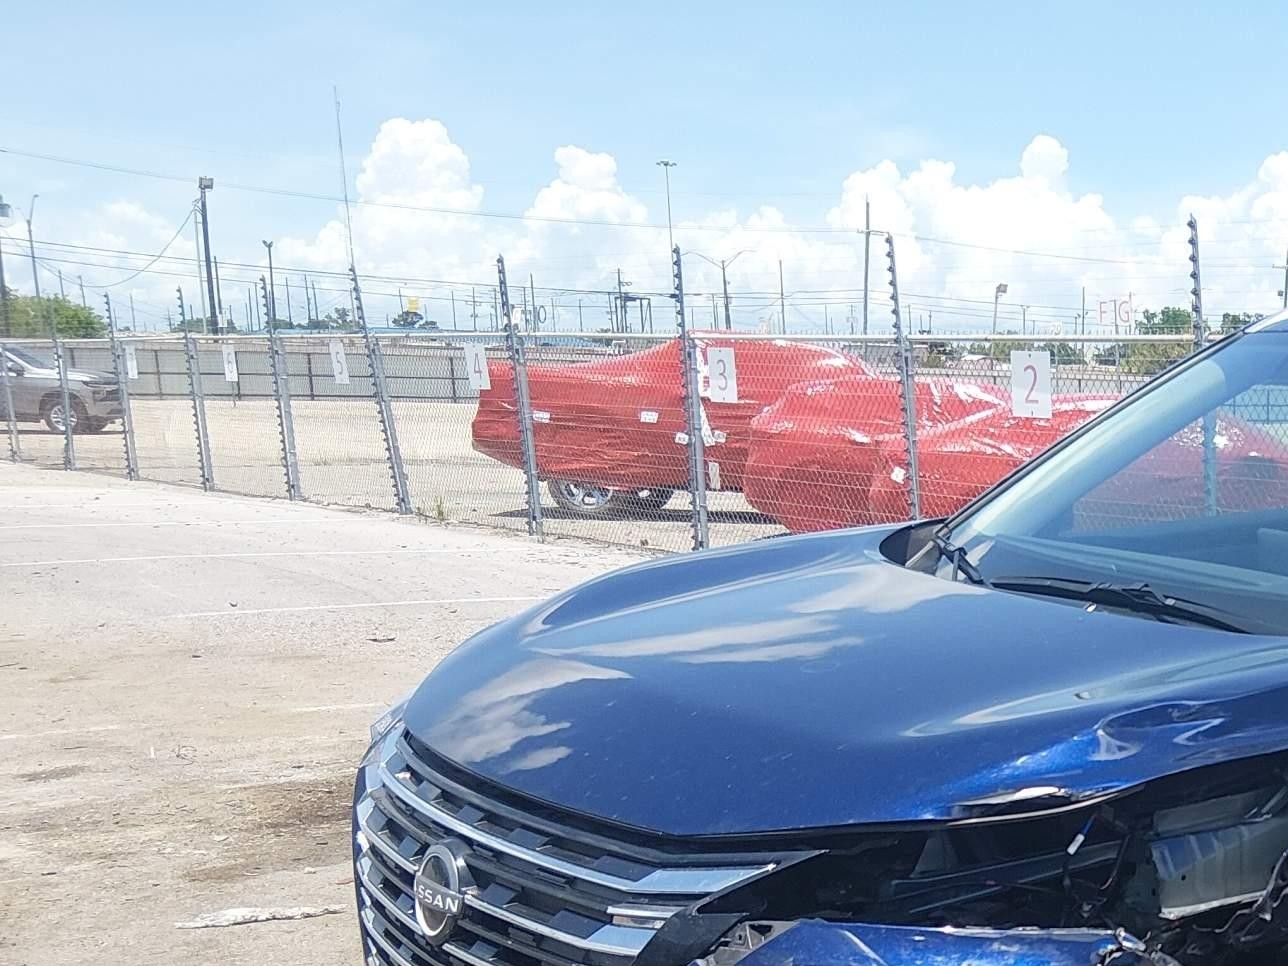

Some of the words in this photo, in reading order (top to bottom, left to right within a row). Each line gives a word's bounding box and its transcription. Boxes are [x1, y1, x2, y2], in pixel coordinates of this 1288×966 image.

[1118, 300, 1130, 323] G
[335, 351, 344, 376] 5
[473, 352, 483, 381] 4
[716, 359, 729, 391] 3
[1023, 364, 1040, 404] 2
[416, 884, 459, 913] SSAN
